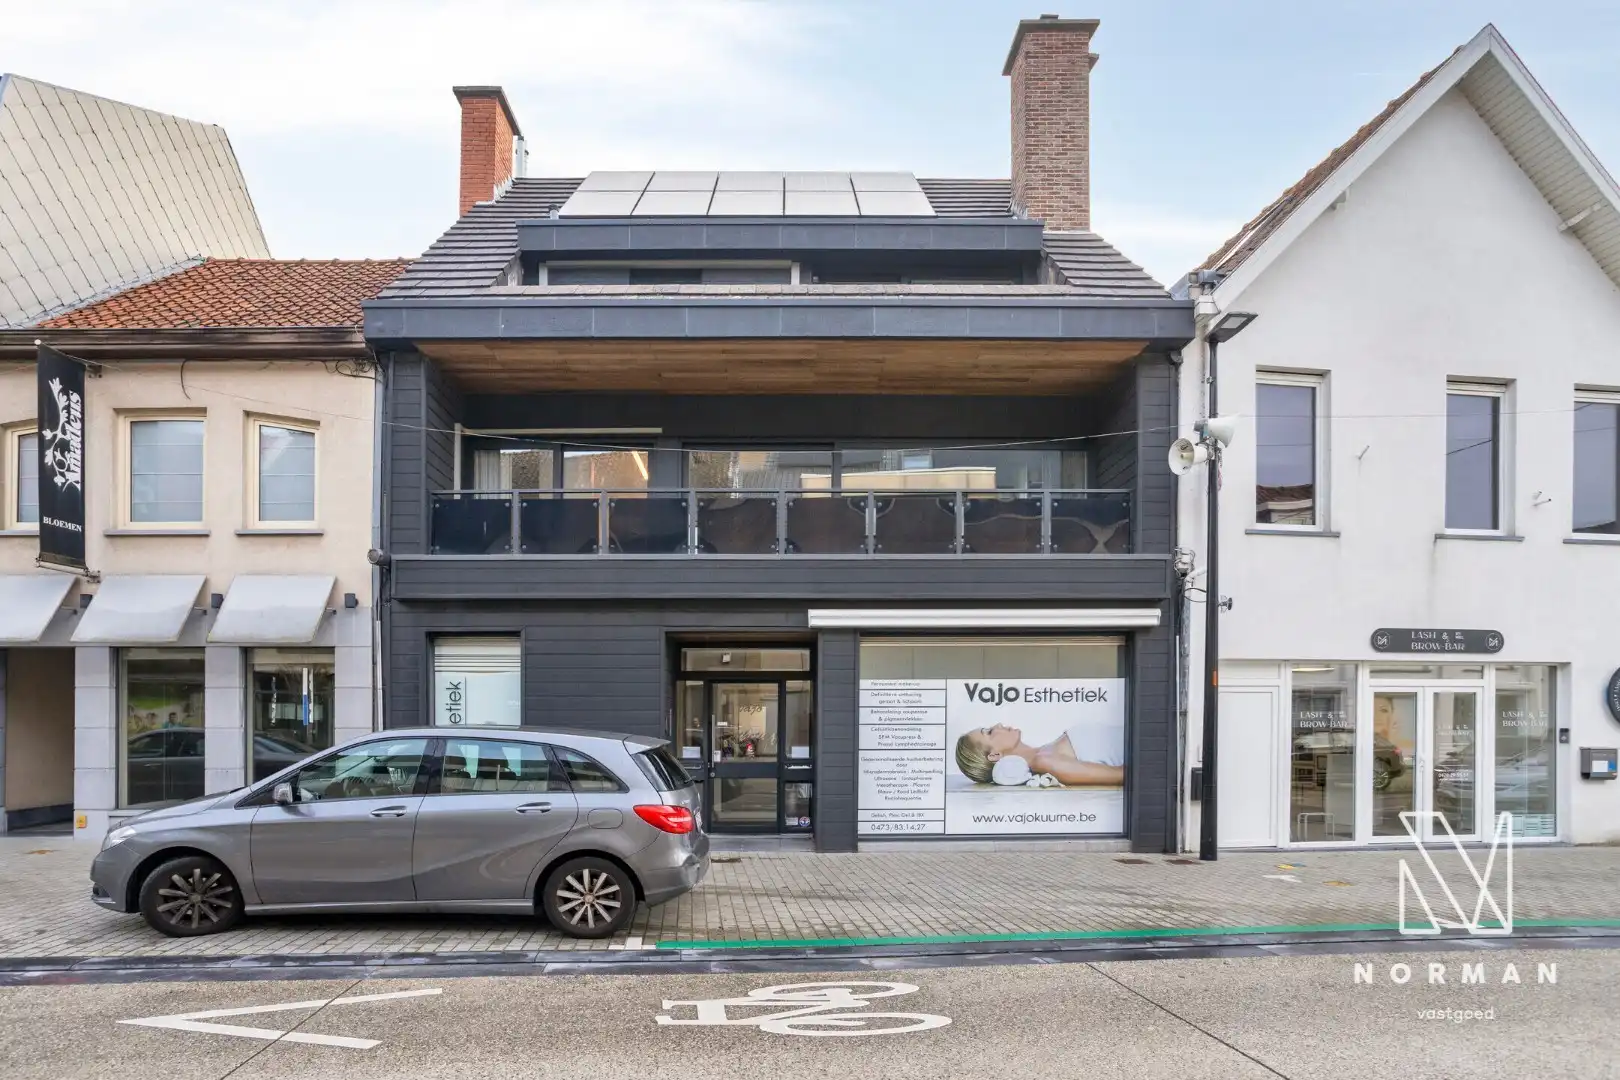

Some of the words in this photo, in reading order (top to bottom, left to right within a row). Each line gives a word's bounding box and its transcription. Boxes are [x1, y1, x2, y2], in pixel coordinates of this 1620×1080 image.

[63, 390, 82, 492] Amadeus
[43, 516, 82, 533] BLOEMEN
[1411, 631, 1436, 639] LASH
[1442, 632, 1450, 642] &
[1411, 642, 1465, 650] BROW-BAR
[964, 682, 1020, 706] Vajo
[1024, 686, 1108, 703] Esthetiek
[972, 812, 1096, 824] www.vajokuurne.be
[870, 824, 926, 832] 0473/83.14.27
